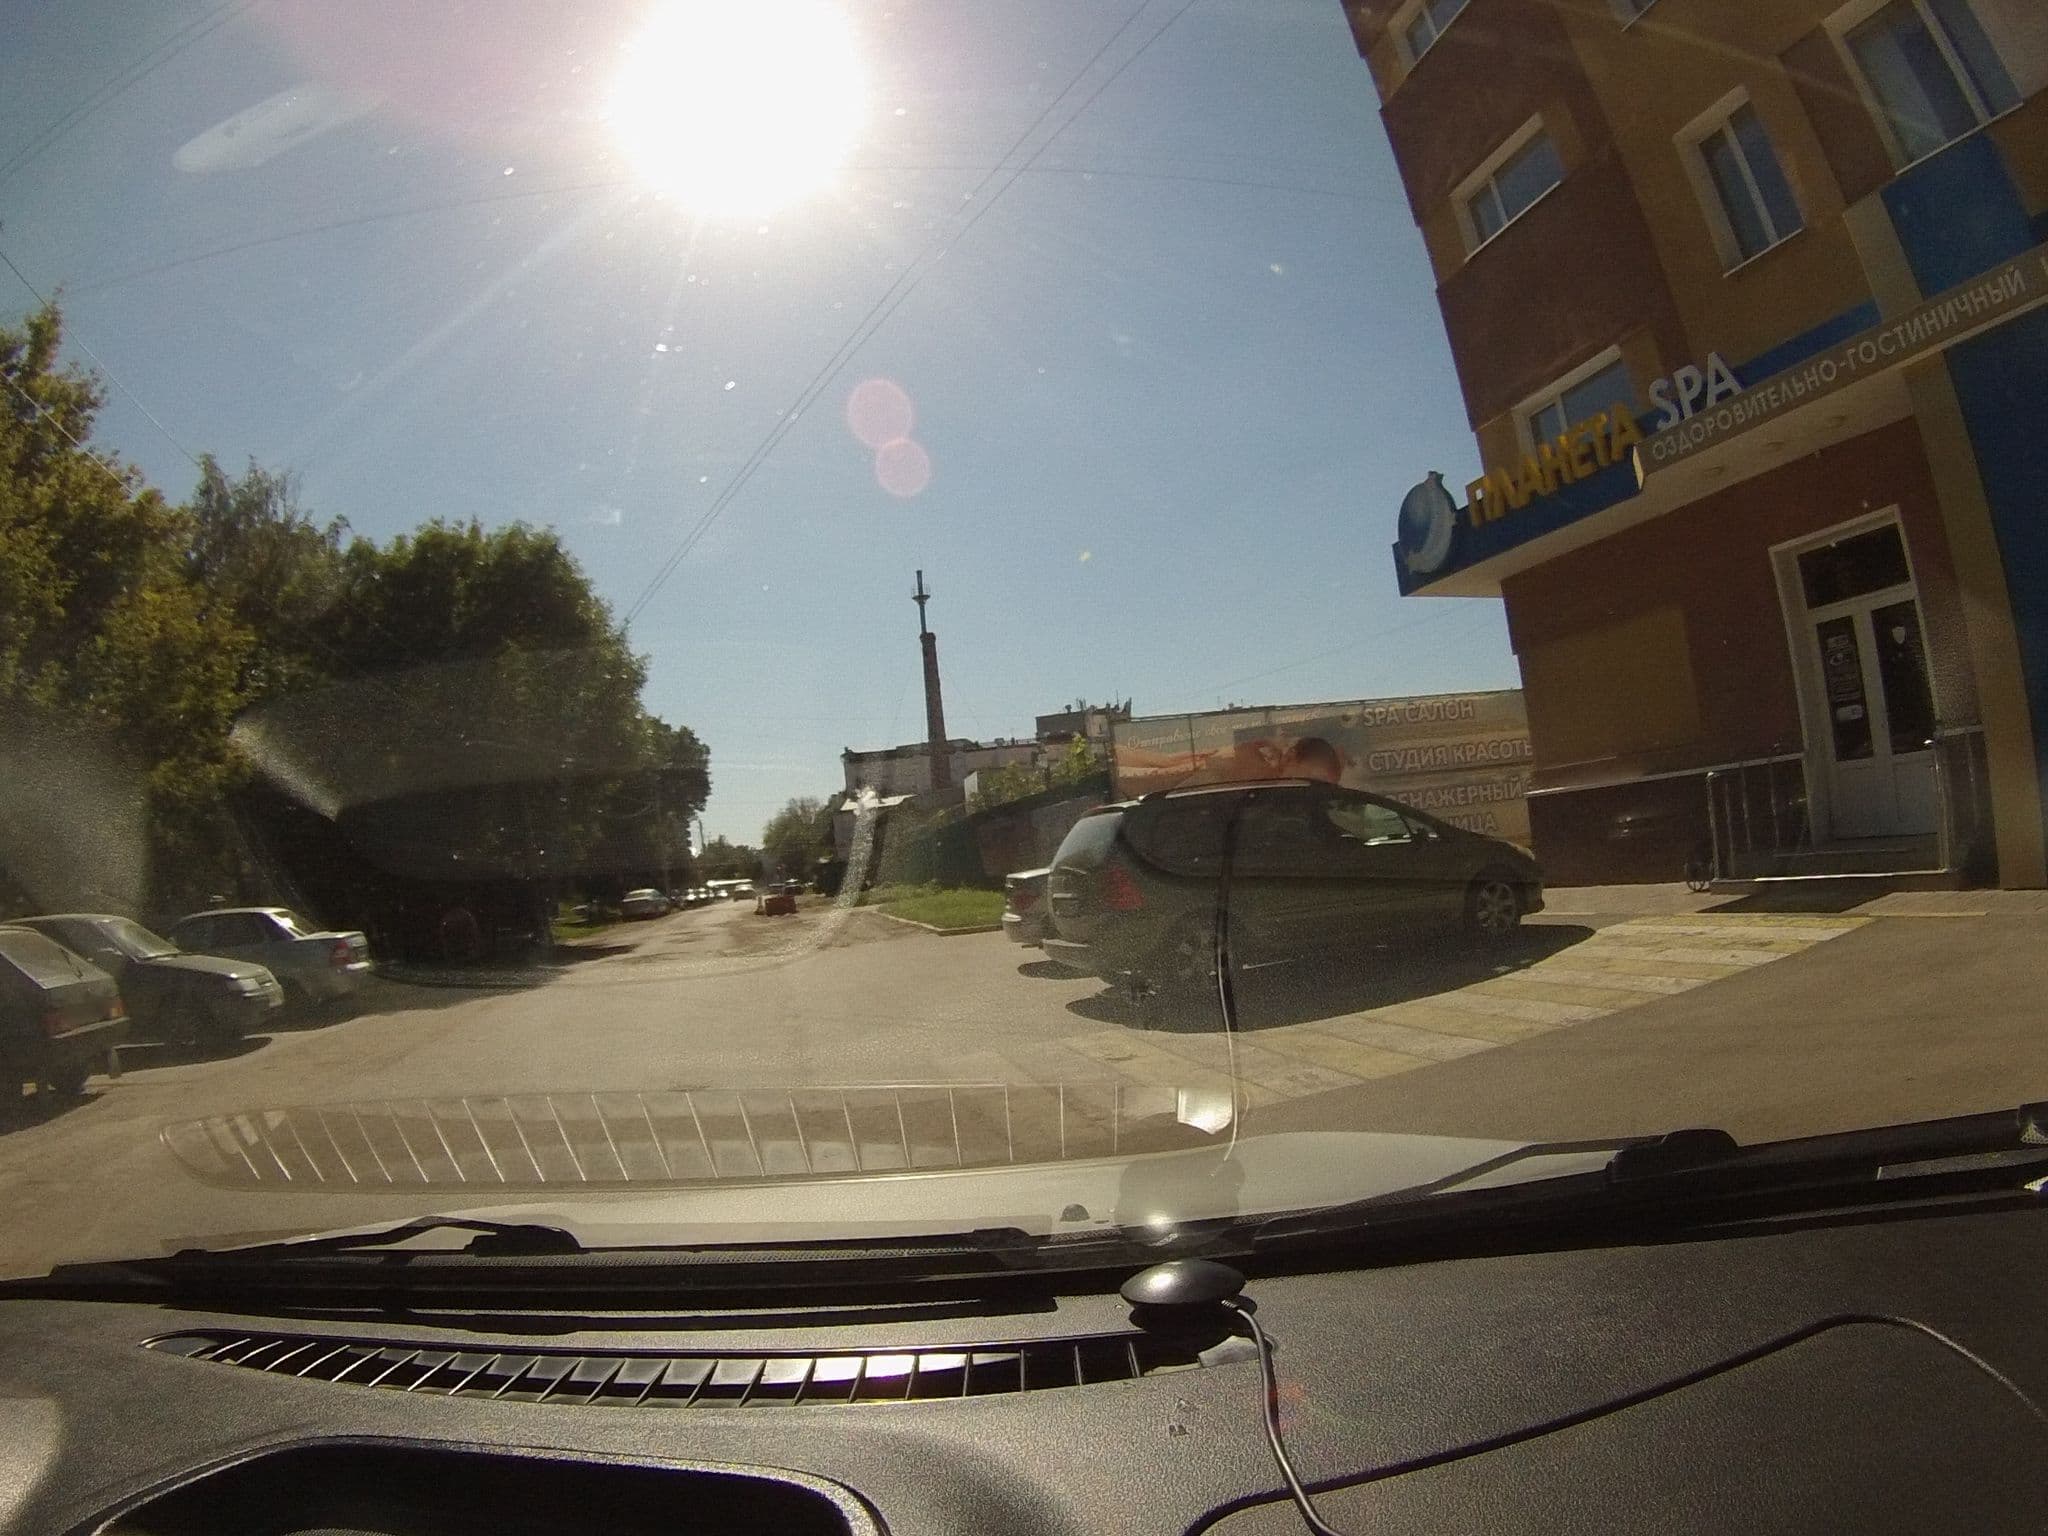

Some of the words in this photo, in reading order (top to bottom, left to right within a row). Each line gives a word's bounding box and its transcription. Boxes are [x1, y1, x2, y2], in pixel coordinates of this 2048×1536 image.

[1469, 404, 1643, 527] ПЛАНЕТА
[1649, 352, 1743, 430] SPA
[1363, 705, 1400, 727] SPA
[1406, 702, 1474, 722] САЛОН
[1369, 746, 1447, 771] СТУДИЯ
[1385, 776, 1522, 809] ЕНАЖЕРНЫЙ
